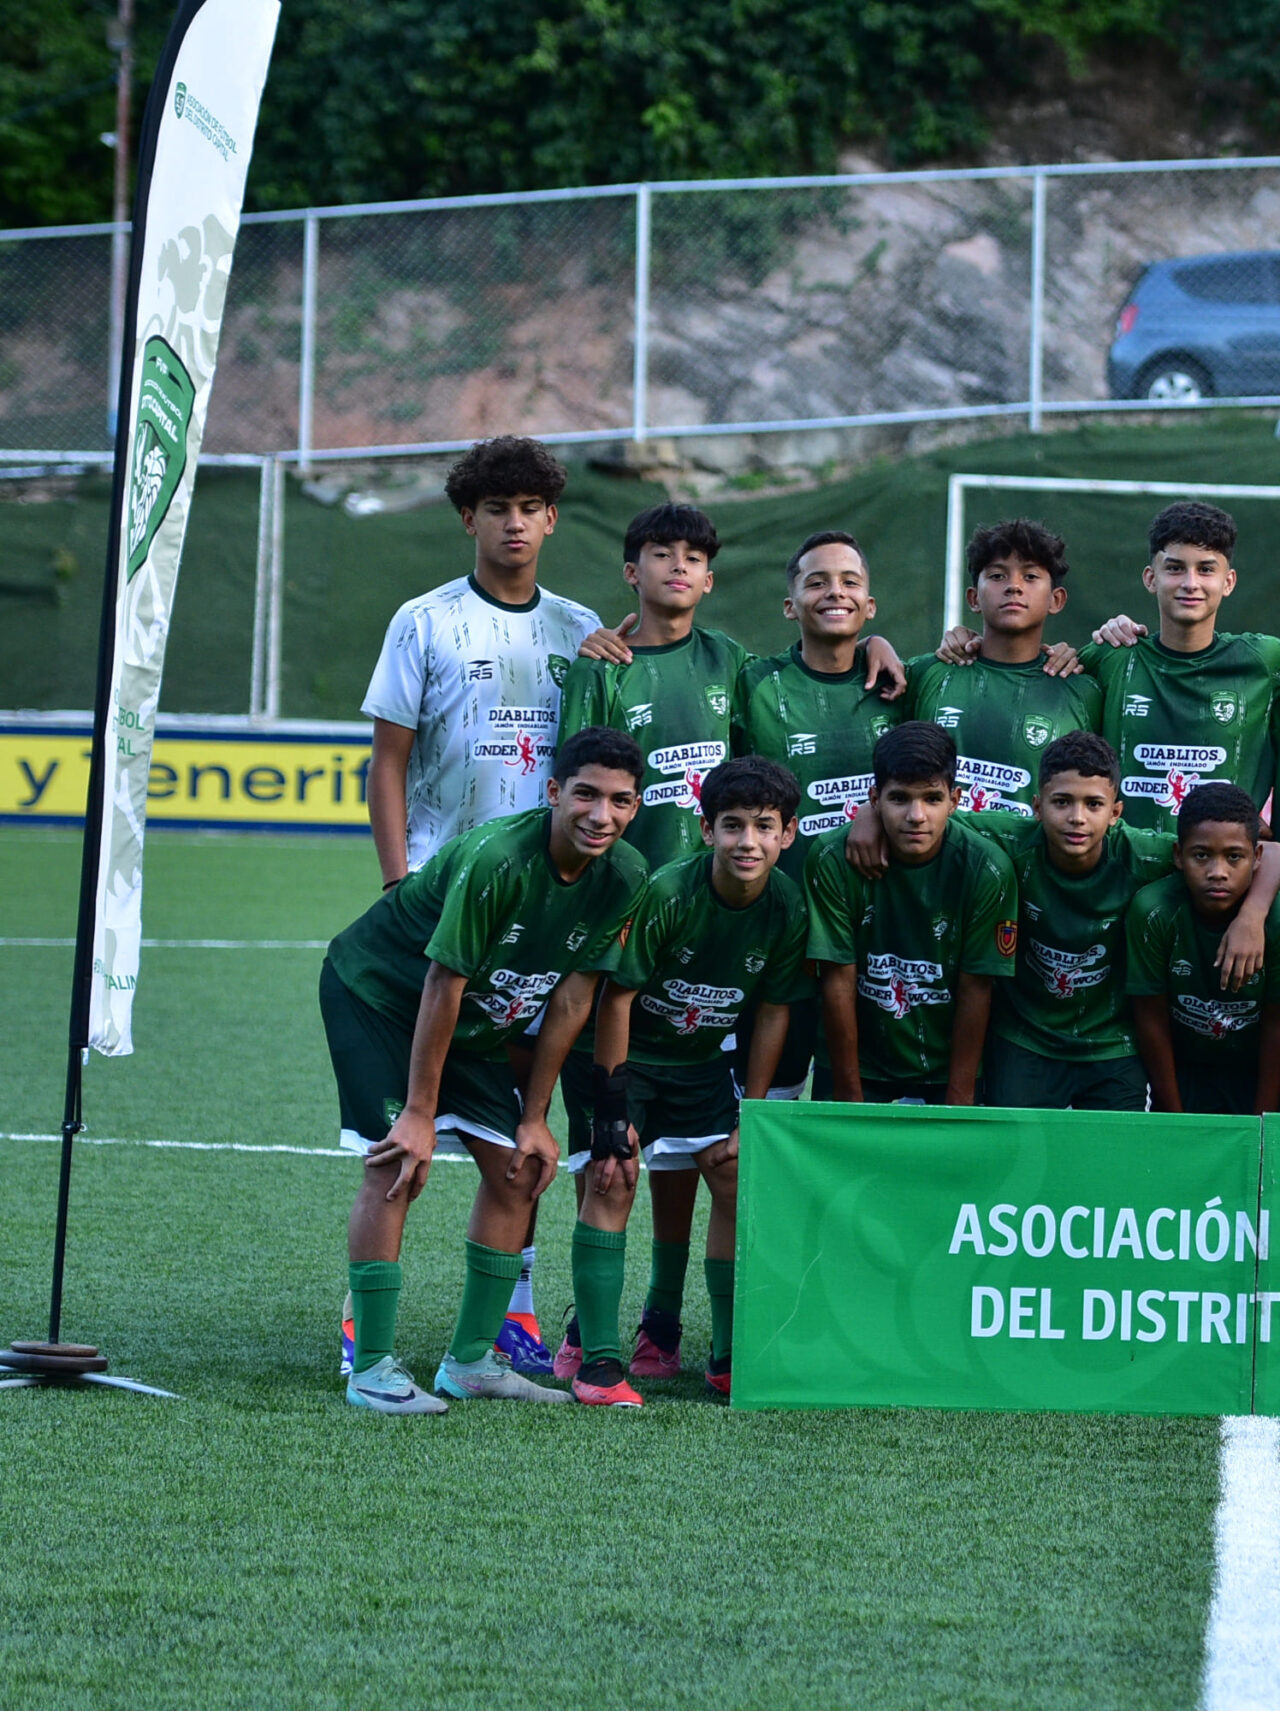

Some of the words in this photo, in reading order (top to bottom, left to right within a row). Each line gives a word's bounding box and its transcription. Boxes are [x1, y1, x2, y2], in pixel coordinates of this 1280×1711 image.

[470, 668, 493, 681] RS
[489, 710, 556, 723] DIABLITOS
[1125, 704, 1149, 717] RS
[631, 710, 652, 730] RS
[937, 716, 960, 728] RS
[474, 745, 518, 756] UNDER
[655, 744, 722, 765] DIABLITOS
[791, 741, 816, 756] RS
[1141, 747, 1219, 761] DIABLITOS
[957, 760, 1024, 783] IABLITOS
[20, 757, 59, 806] y
[815, 777, 876, 796] DIABLITO
[1124, 781, 1169, 794] UNDER
[646, 784, 688, 802] UNDER
[803, 816, 847, 832] UNDER
[669, 981, 737, 999] DIABLITOS
[907, 991, 950, 1003] WOOD
[948, 1195, 1269, 1263] ASOCIACIÓN
[970, 1286, 1065, 1340] DEL
